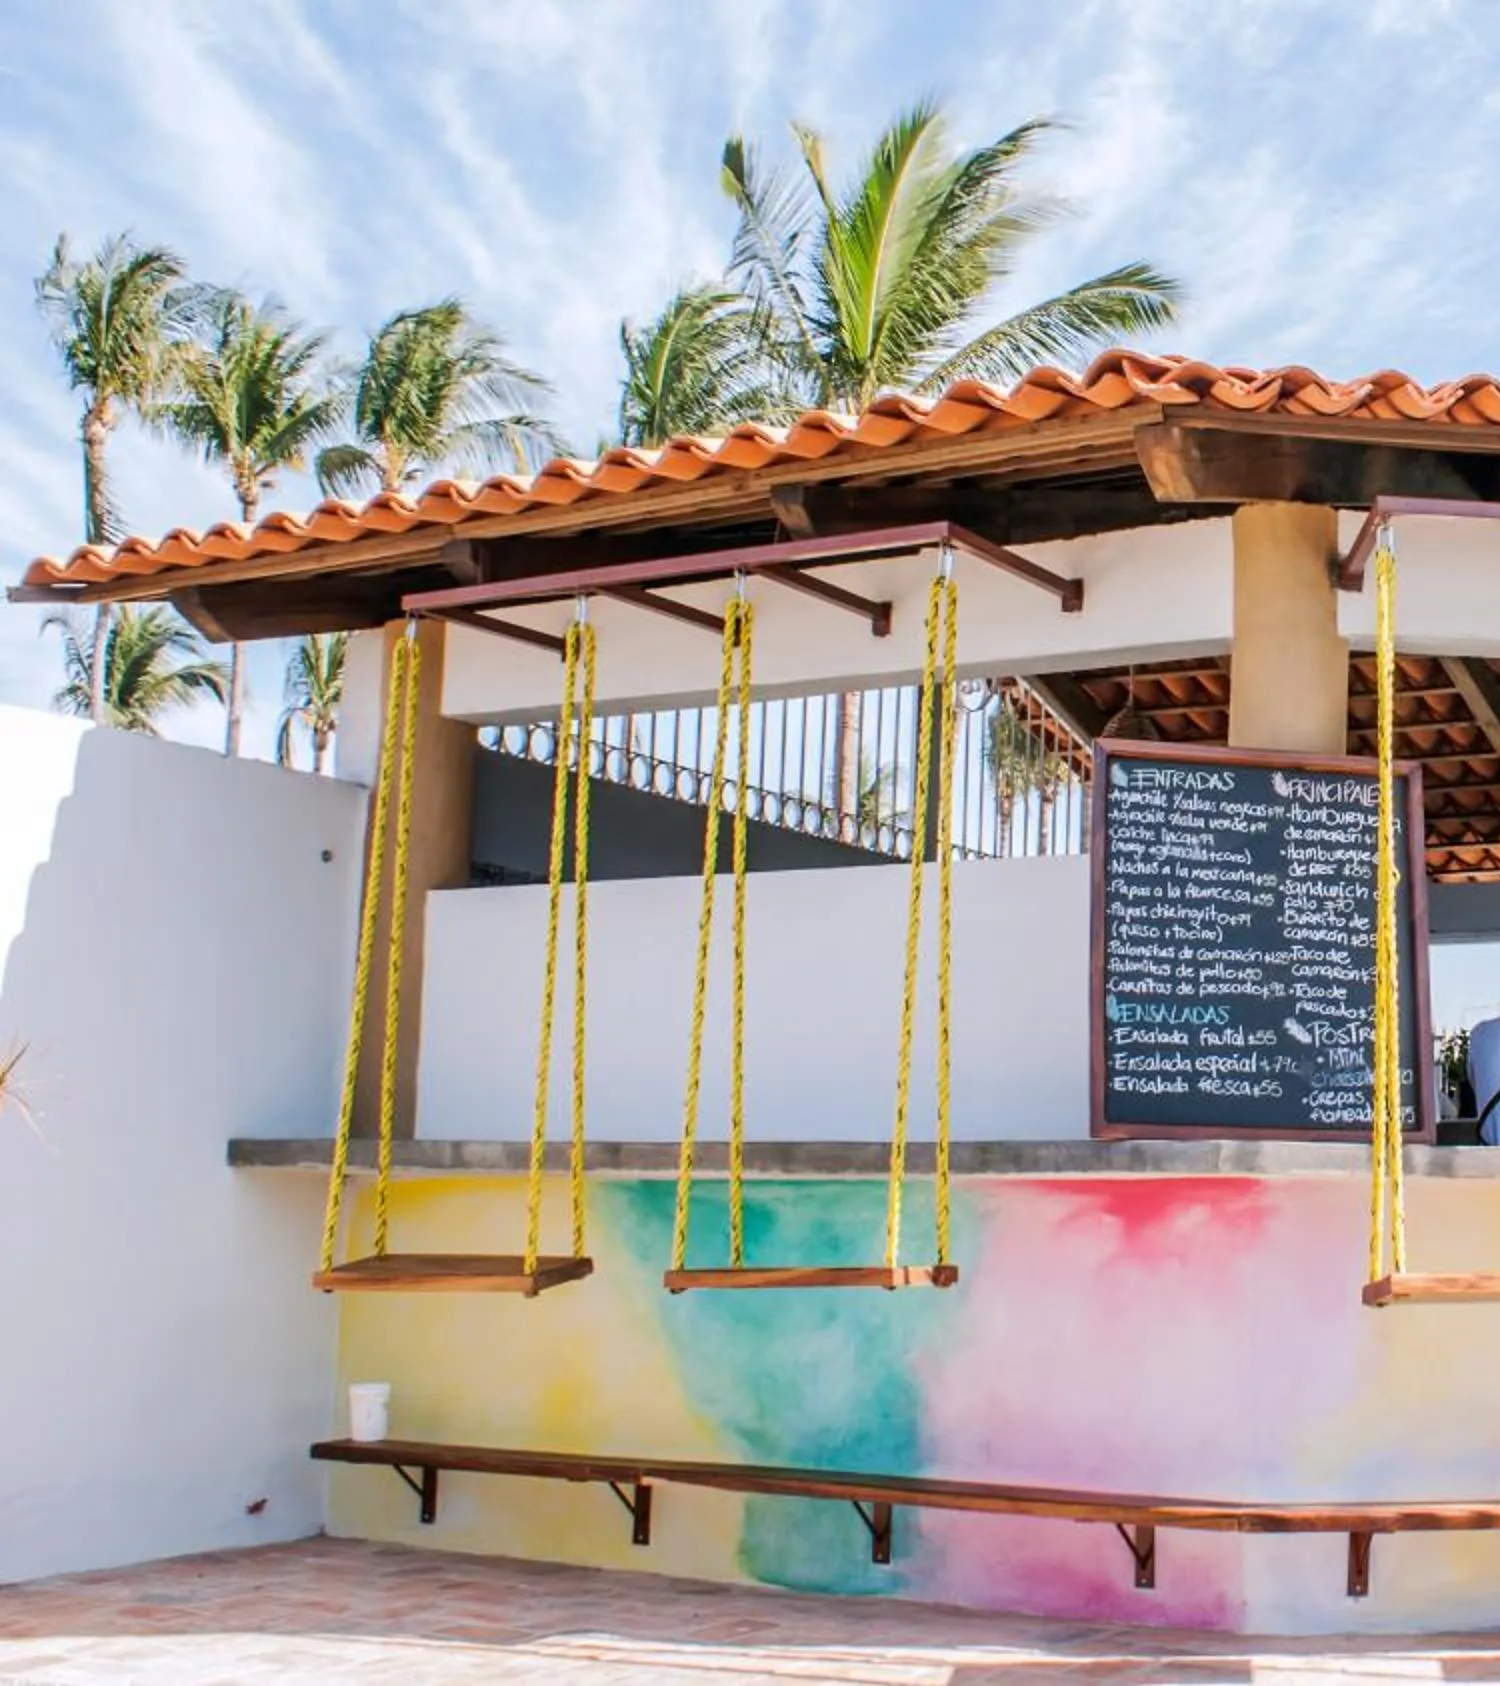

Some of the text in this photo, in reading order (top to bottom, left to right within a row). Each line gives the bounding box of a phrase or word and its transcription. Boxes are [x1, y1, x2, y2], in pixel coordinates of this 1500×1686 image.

[1130, 768, 1236, 792] ENTRADAS
[1288, 778, 1381, 807] PRINCIPALE
[1111, 857, 1159, 875] Nachos
[1175, 861, 1189, 878] la
[1111, 879, 1151, 900] Papas
[1167, 881, 1181, 899] la
[1111, 902, 1148, 923] Papas
[1291, 945, 1351, 965] Taco de
[1175, 963, 1195, 977] de
[1175, 981, 1195, 996] de
[1293, 982, 1348, 1000] Taco de
[1119, 1003, 1231, 1025] ENSALADAS
[1113, 1026, 1189, 1046] Ensalada
[1305, 1020, 1376, 1049] POSTR
[1113, 1051, 1193, 1073] Ensalada
[1195, 1051, 1257, 1079] especial
[1113, 1075, 1189, 1094] Ensalada
[1197, 1075, 1251, 1096] fresca
